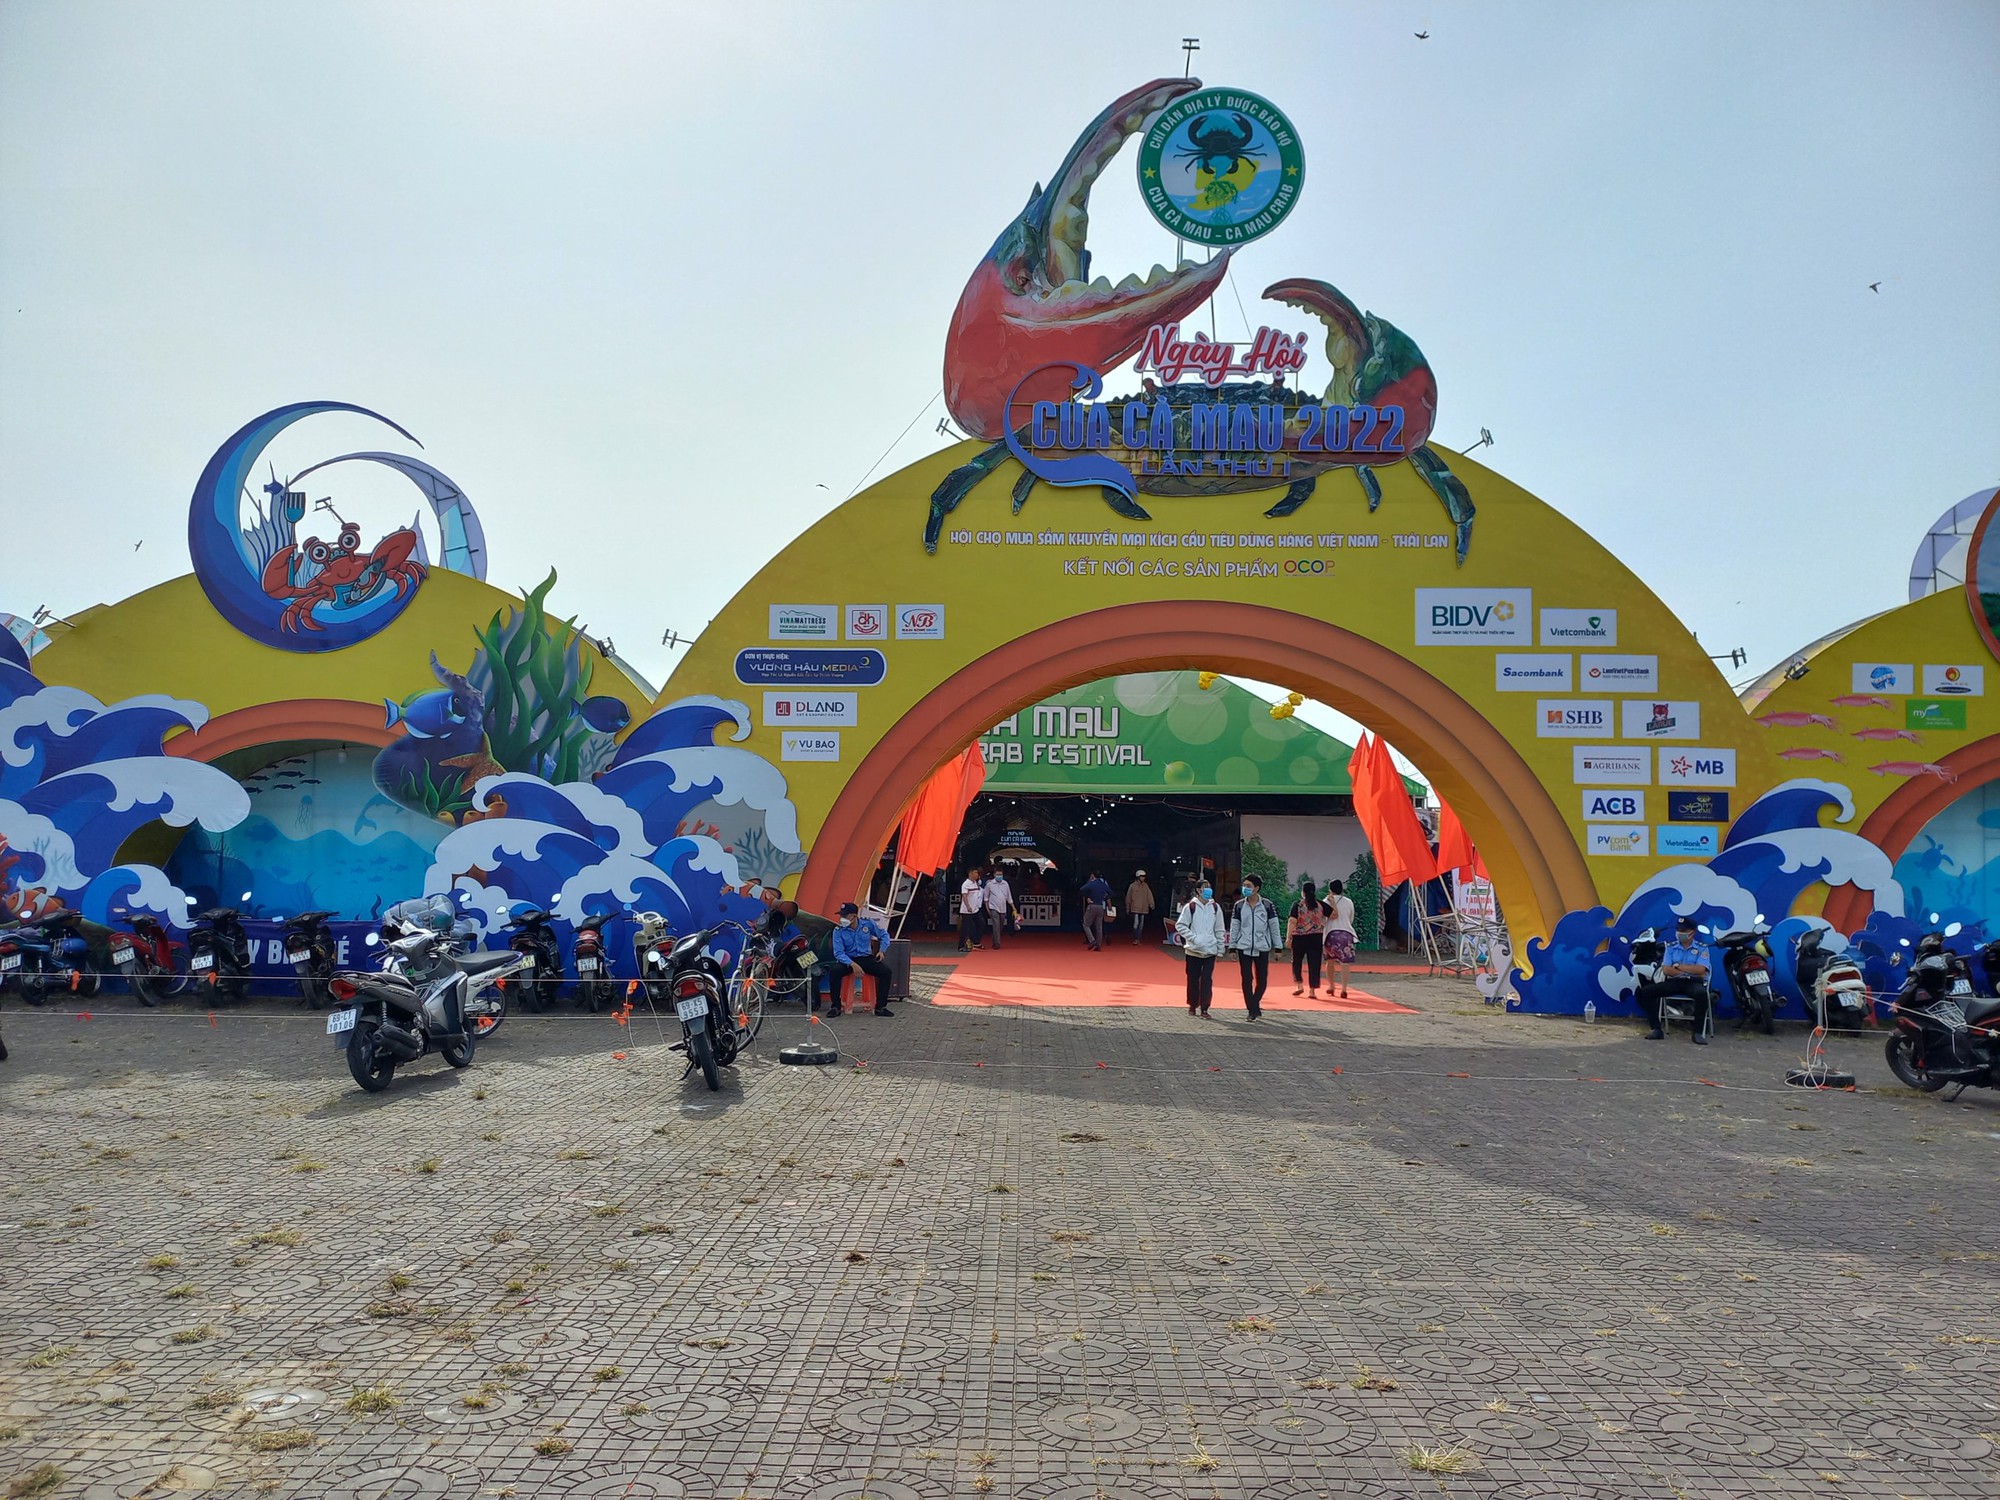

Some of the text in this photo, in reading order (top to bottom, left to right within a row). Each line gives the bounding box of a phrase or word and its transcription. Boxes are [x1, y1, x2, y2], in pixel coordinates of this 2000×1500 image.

[1150, 127, 1166, 149] CHỈ
[1184, 100, 1205, 116] ĐỊA
[1207, 93, 1221, 107] LÝ
[1226, 96, 1259, 114] ĐƯỢC
[1258, 112, 1281, 131] BẢO
[1183, 220, 1212, 240] MAU
[1225, 227, 1244, 240] CA
[1244, 211, 1273, 235] MAU
[1270, 183, 1294, 216] CRAB
[1135, 324, 1307, 387] Ngày Hội
[1122, 394, 1174, 451] CÀ
[1191, 402, 1285, 452] MAU
[1298, 404, 1406, 453] 2022
[950, 528, 972, 547] HỘI
[976, 530, 1001, 548] CHỢ
[1005, 531, 1034, 545] MUA
[1068, 529, 1118, 546] KHUYẾN
[1121, 533, 1146, 549] MẠI
[1150, 531, 1178, 547] KÍCH
[1210, 531, 1235, 548] TIÊU
[1241, 532, 1274, 548] DÙNG
[1278, 532, 1313, 548] HÀNG
[1318, 532, 1344, 550] VIỆT
[1348, 535, 1378, 548] NAM
[1392, 532, 1420, 548] THÁI
[1424, 536, 1449, 548] LAN
[1064, 556, 1335, 578] KẾT NỐI CÁC SẢN PHẨM OCOP
[1432, 605, 1493, 627] BIDV
[1550, 627, 1606, 637] Vietcombank
[749, 662, 791, 672] VƯƠNG
[822, 664, 858, 672] MEDIA
[1503, 667, 1564, 677] Sacombank
[796, 702, 845, 713] DLAND
[1033, 706, 1119, 738] MAU
[1566, 710, 1603, 724] SHB
[799, 740, 836, 749] VU BAO
[1033, 743, 1151, 766] FESTIVAL
[1593, 762, 1640, 770] AGRIBANK
[1695, 760, 1724, 775] MB
[1591, 797, 1636, 815] ACB
[1610, 843, 1632, 851] Bank
[1665, 839, 1701, 847] VietinBank
[683, 1007, 705, 1019] 9553
